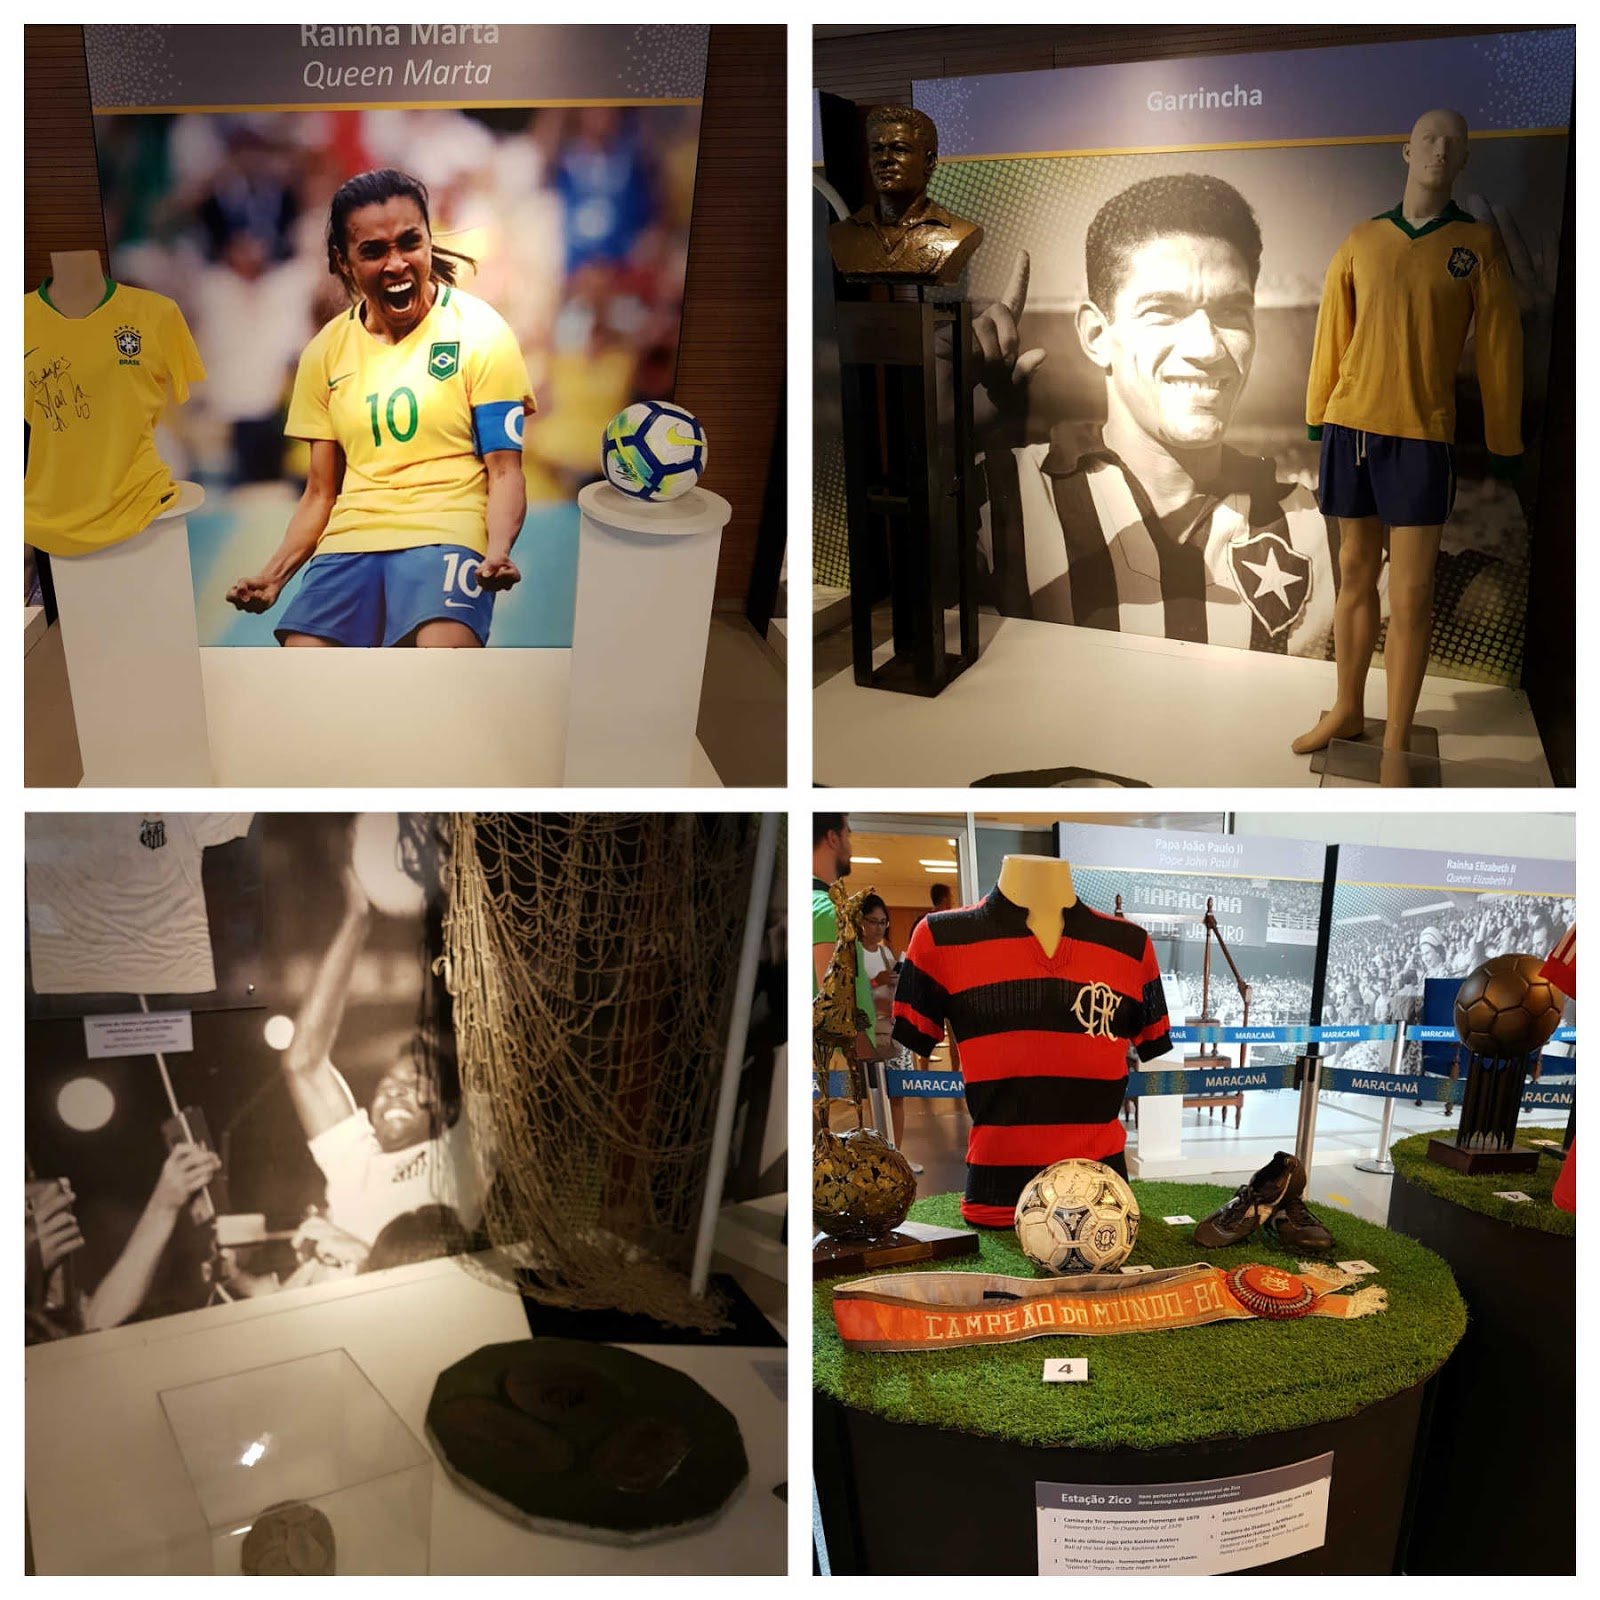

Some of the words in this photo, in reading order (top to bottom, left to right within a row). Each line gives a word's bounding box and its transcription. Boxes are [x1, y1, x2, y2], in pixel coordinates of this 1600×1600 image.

[300, 24, 400, 47] Rainha
[410, 24, 499, 45] Marta
[303, 60, 393, 90] Queen
[403, 58, 492, 86] Marta
[1146, 83, 1263, 112] Garrincha
[366, 386, 419, 448] 10
[442, 552, 484, 599] 10
[1155, 838, 1180, 852] Papa
[1182, 839, 1204, 853] João
[1207, 841, 1235, 855] Paulo
[1159, 852, 1184, 866] Pope
[1186, 854, 1208, 868] John
[1210, 856, 1231, 869] Paul
[1446, 859, 1474, 871] Rainha
[1475, 861, 1509, 873] Elizabeth
[1446, 872, 1472, 884] Queen
[1472, 874, 1506, 885] Elizabeth
[1235, 1030, 1275, 1040] MARACANÃ
[1322, 1030, 1361, 1039] MARACANÃ
[902, 1079, 965, 1091] MARACAN
[1205, 1072, 1267, 1087] MARACANÃ
[1351, 1077, 1419, 1094] MARACANÃ
[1521, 1091, 1573, 1104] RACAN
[925, 1303, 1055, 1341] CAMPEÃO
[1057, 1363, 1073, 1375] 4
[1061, 1493, 1105, 1506] Estação
[1108, 1495, 1132, 1505] Zico
